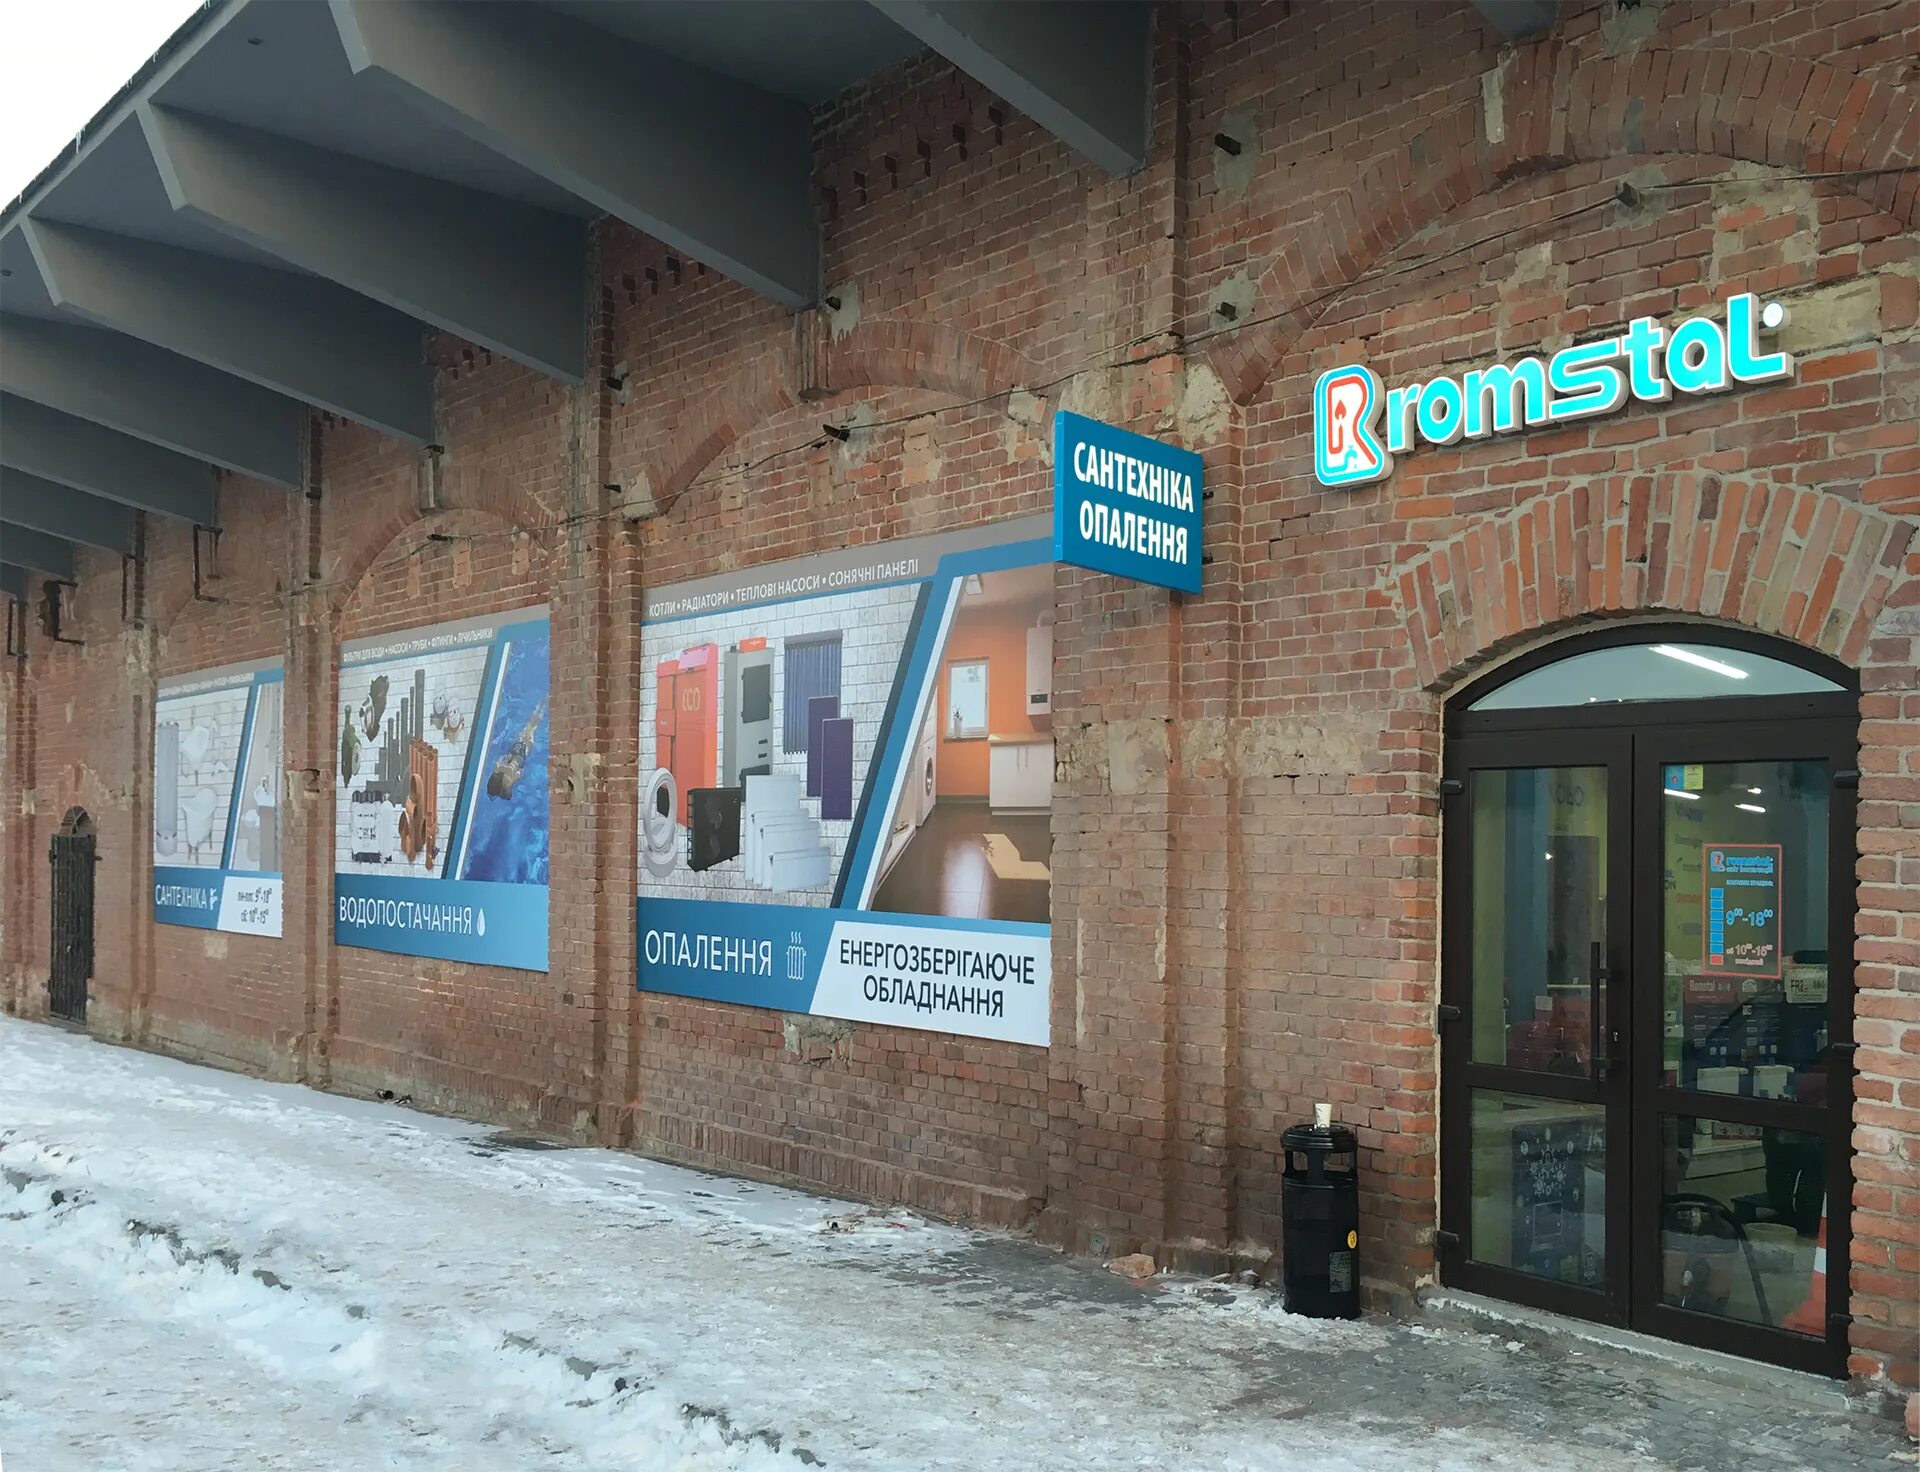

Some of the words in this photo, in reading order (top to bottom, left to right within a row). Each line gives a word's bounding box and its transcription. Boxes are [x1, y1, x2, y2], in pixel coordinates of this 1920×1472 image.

[1073, 441, 1194, 513] САНТЕХНІКА
[1079, 500, 1188, 565] ОПАЛЕННЯ
[649, 600, 676, 618] КОТЛИ
[681, 592, 729, 613] РАДІАТОРИ
[736, 583, 777, 602] ТЕПЛОВІ
[778, 574, 820, 594] НАСОСИ
[828, 566, 875, 587] СОНЯЧНІ
[877, 558, 919, 579] ПАНЕЛІ
[155, 884, 207, 909] САНТЕХНІКА
[339, 896, 473, 935] ВОДОПОСТАЧАННЯ
[644, 928, 773, 977] ОПАЛЕННЯ
[840, 938, 1035, 985] ЕНЕРГОЗБЕРІГАЮЧЕ
[863, 974, 1004, 1018] ОБЛАДНАННЯ
